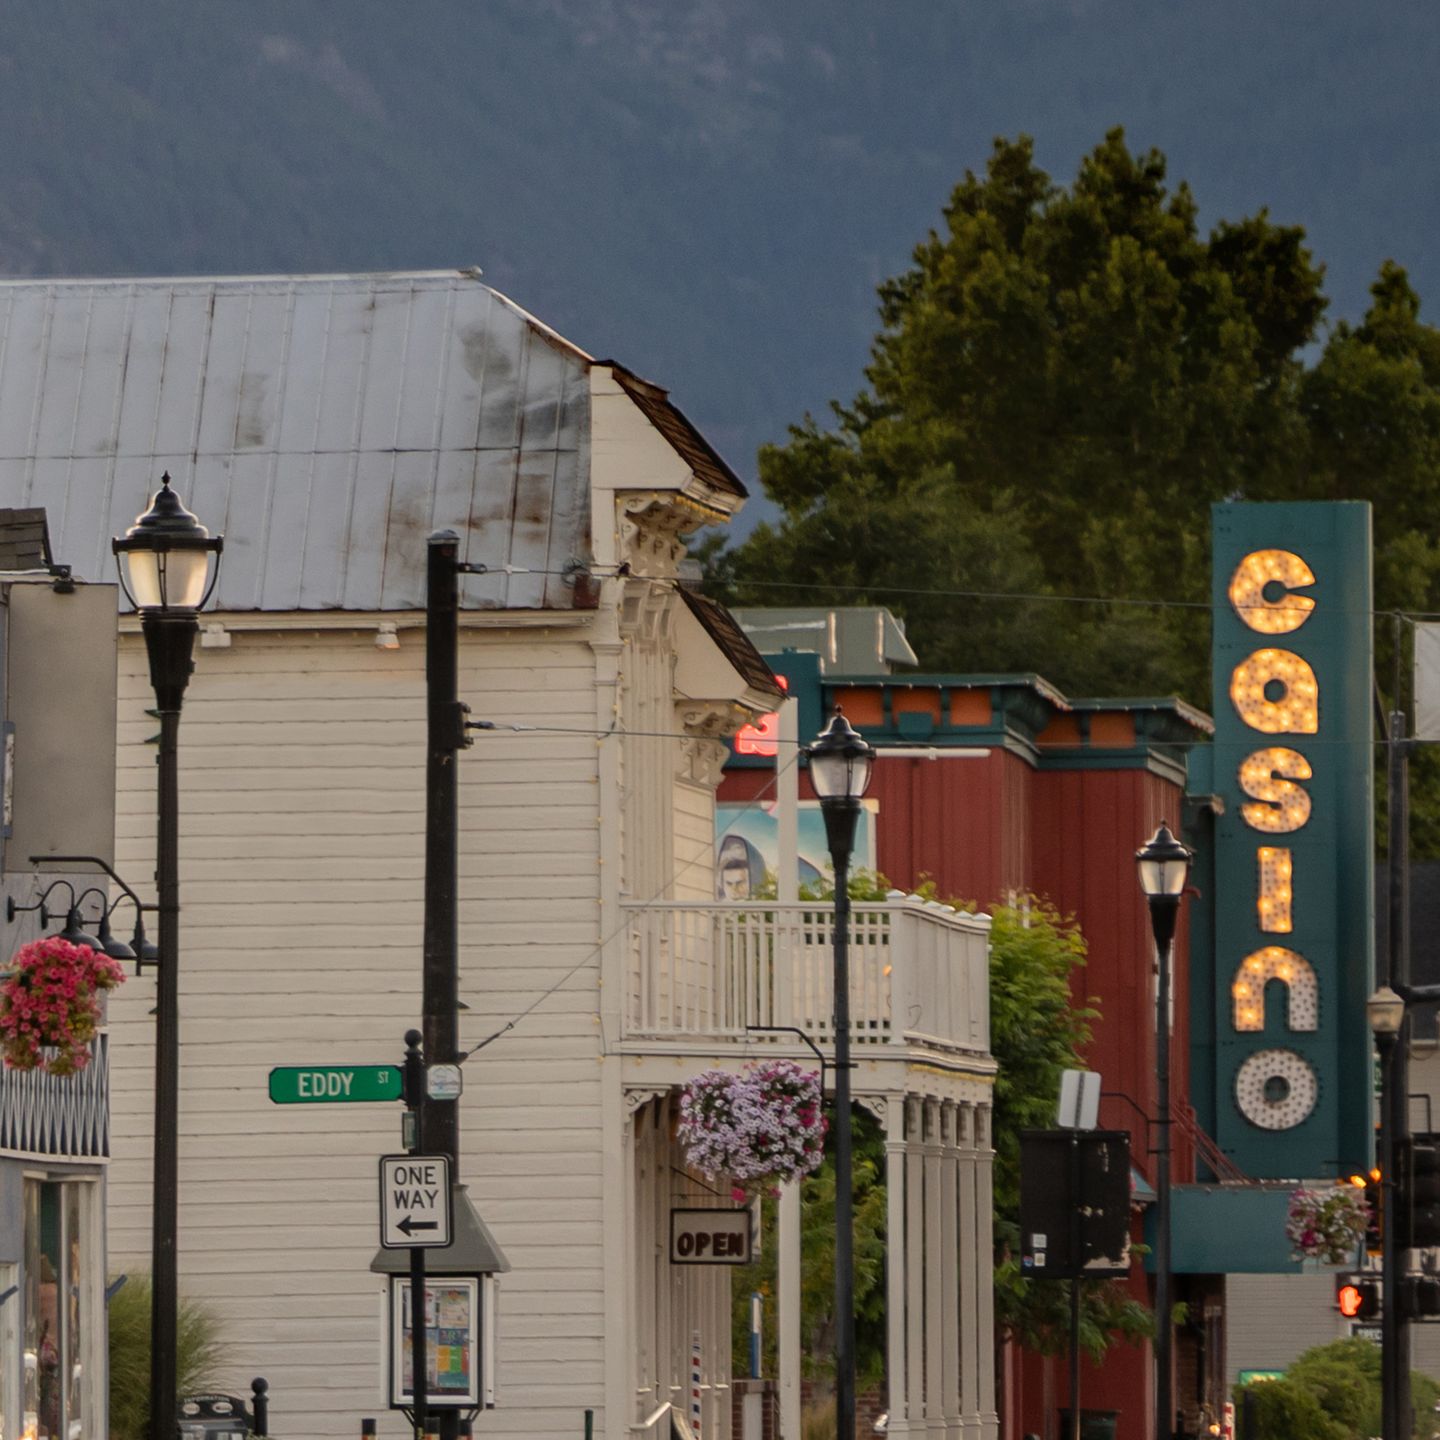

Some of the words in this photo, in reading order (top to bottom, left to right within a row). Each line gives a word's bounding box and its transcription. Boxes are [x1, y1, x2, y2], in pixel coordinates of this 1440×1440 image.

[298, 1072, 354, 1097] EDDY
[377, 1071, 390, 1084] ST
[394, 1166, 436, 1186] ONE
[394, 1190, 438, 1210] WAY
[677, 1232, 744, 1257] OPEN
